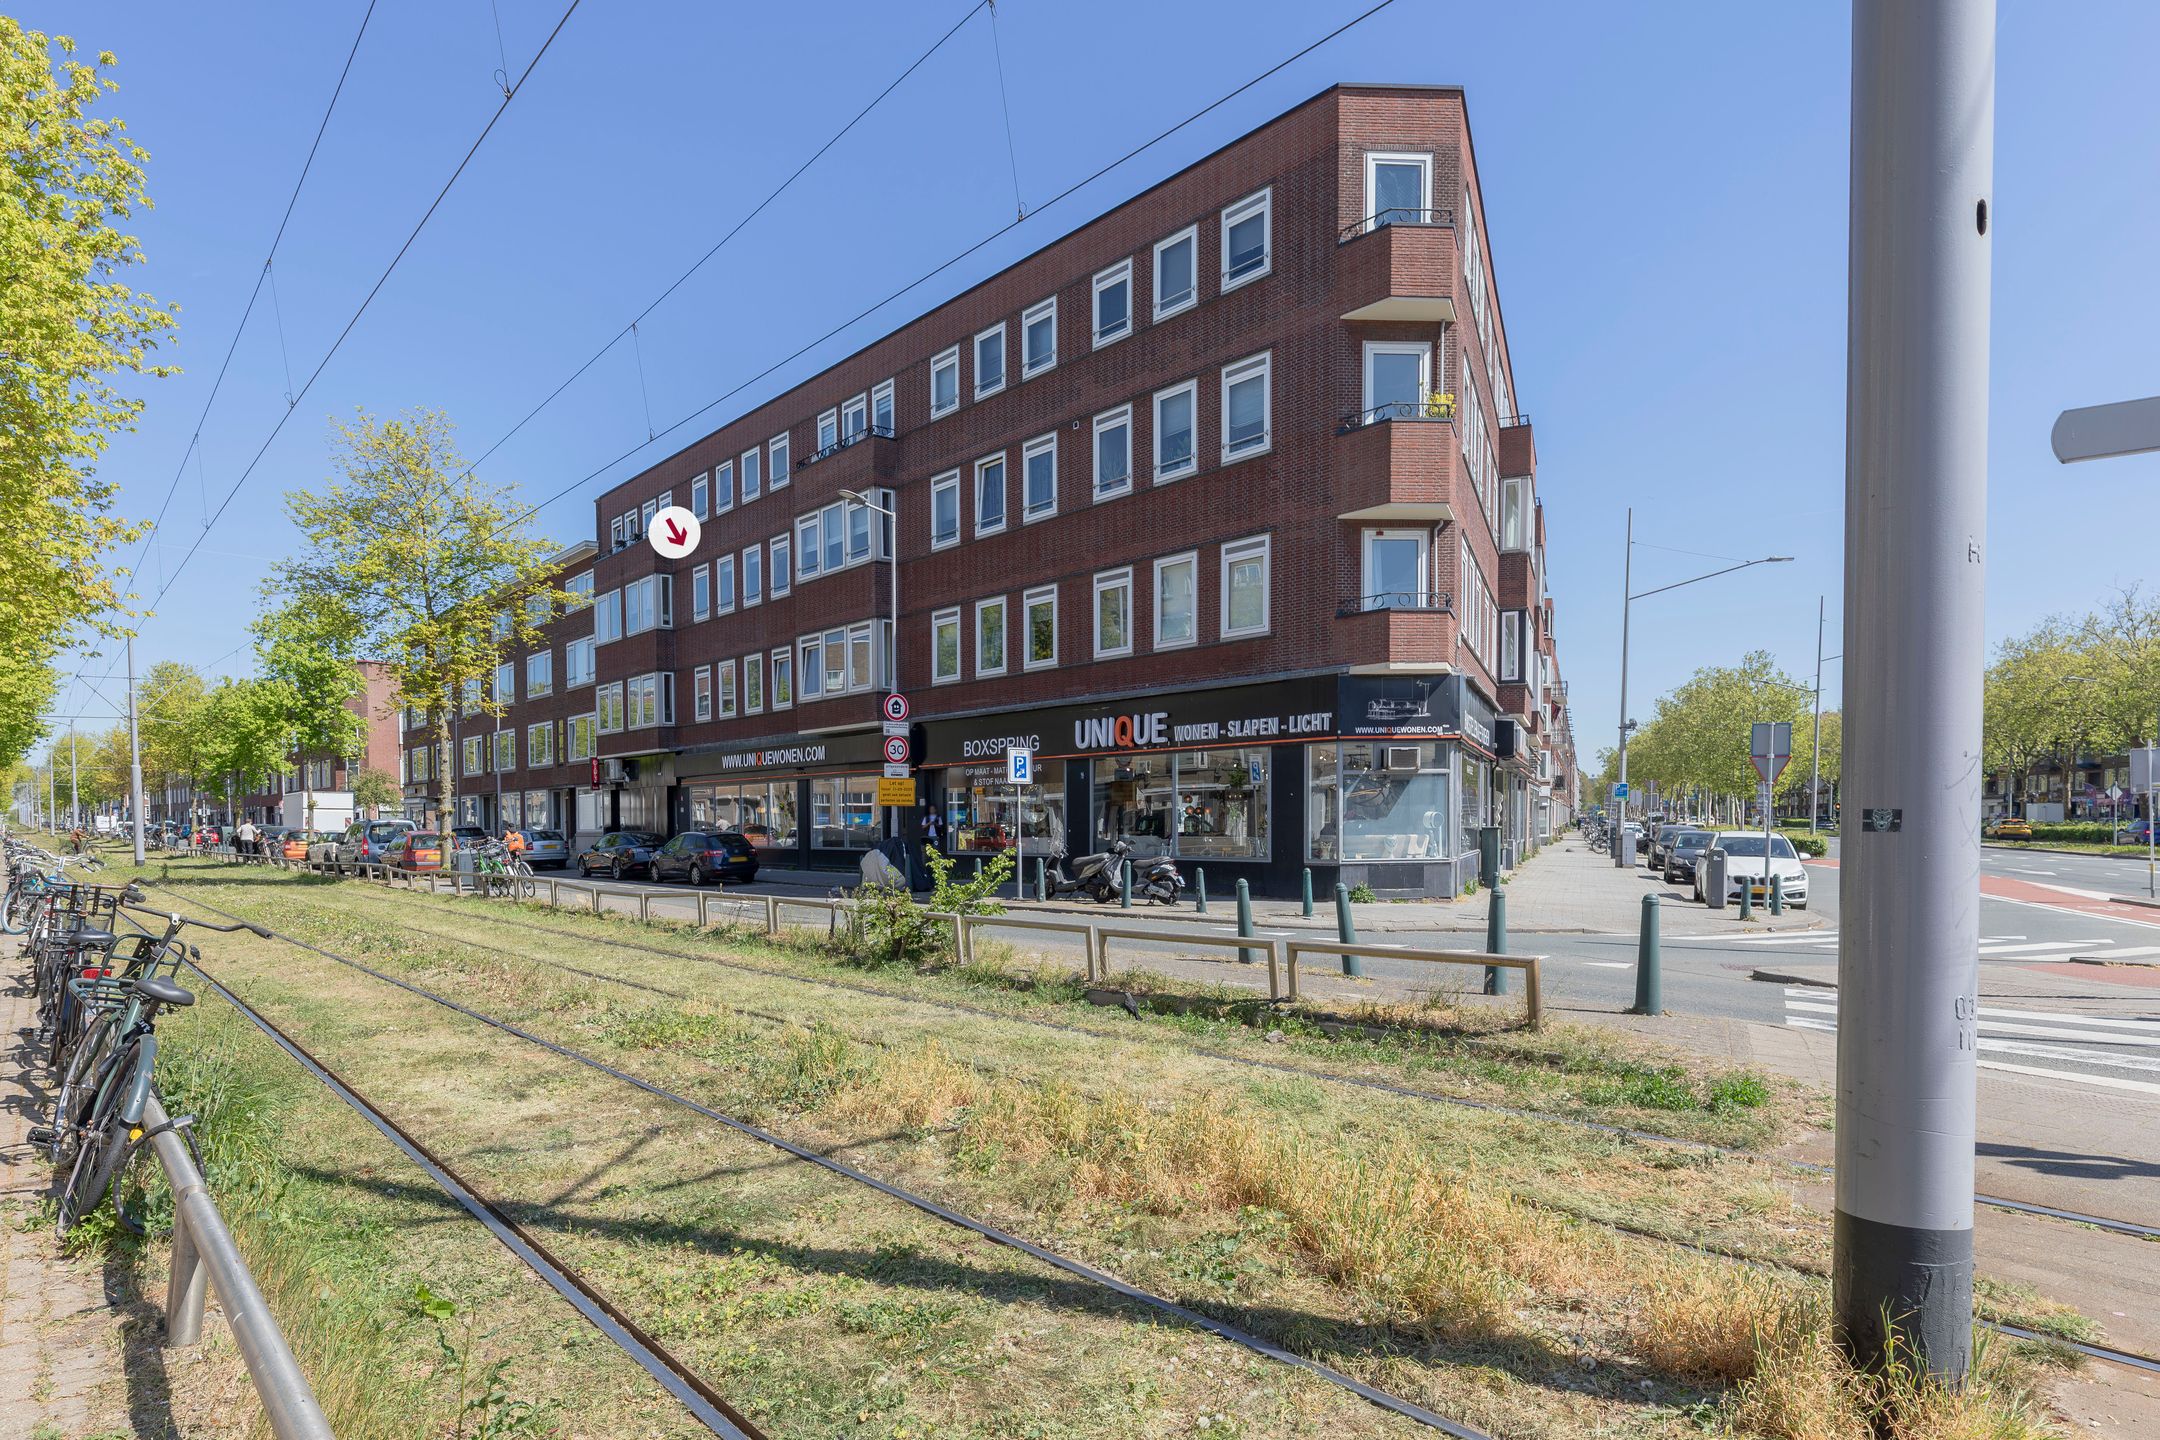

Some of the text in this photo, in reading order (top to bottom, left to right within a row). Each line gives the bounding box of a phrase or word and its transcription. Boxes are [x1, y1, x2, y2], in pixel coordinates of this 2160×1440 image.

[1075, 712, 1168, 749] UNIQUE
[1174, 722, 1219, 742] WONEN
[1227, 716, 1279, 737] SLAPEN
[1289, 712, 1332, 733] LICHT
[1355, 726, 1443, 735] WWW.UNIQUEWONEN.COM
[889, 744, 905, 755] 30
[963, 734, 1040, 757] BOXSPRING
[721, 745, 826, 769] WWW.UNIQUEWONEN.COM
[1017, 757, 1024, 769] P
[965, 768, 974, 776] OP
[974, 767, 990, 776] MAAT
[979, 778, 994, 786] STOF
